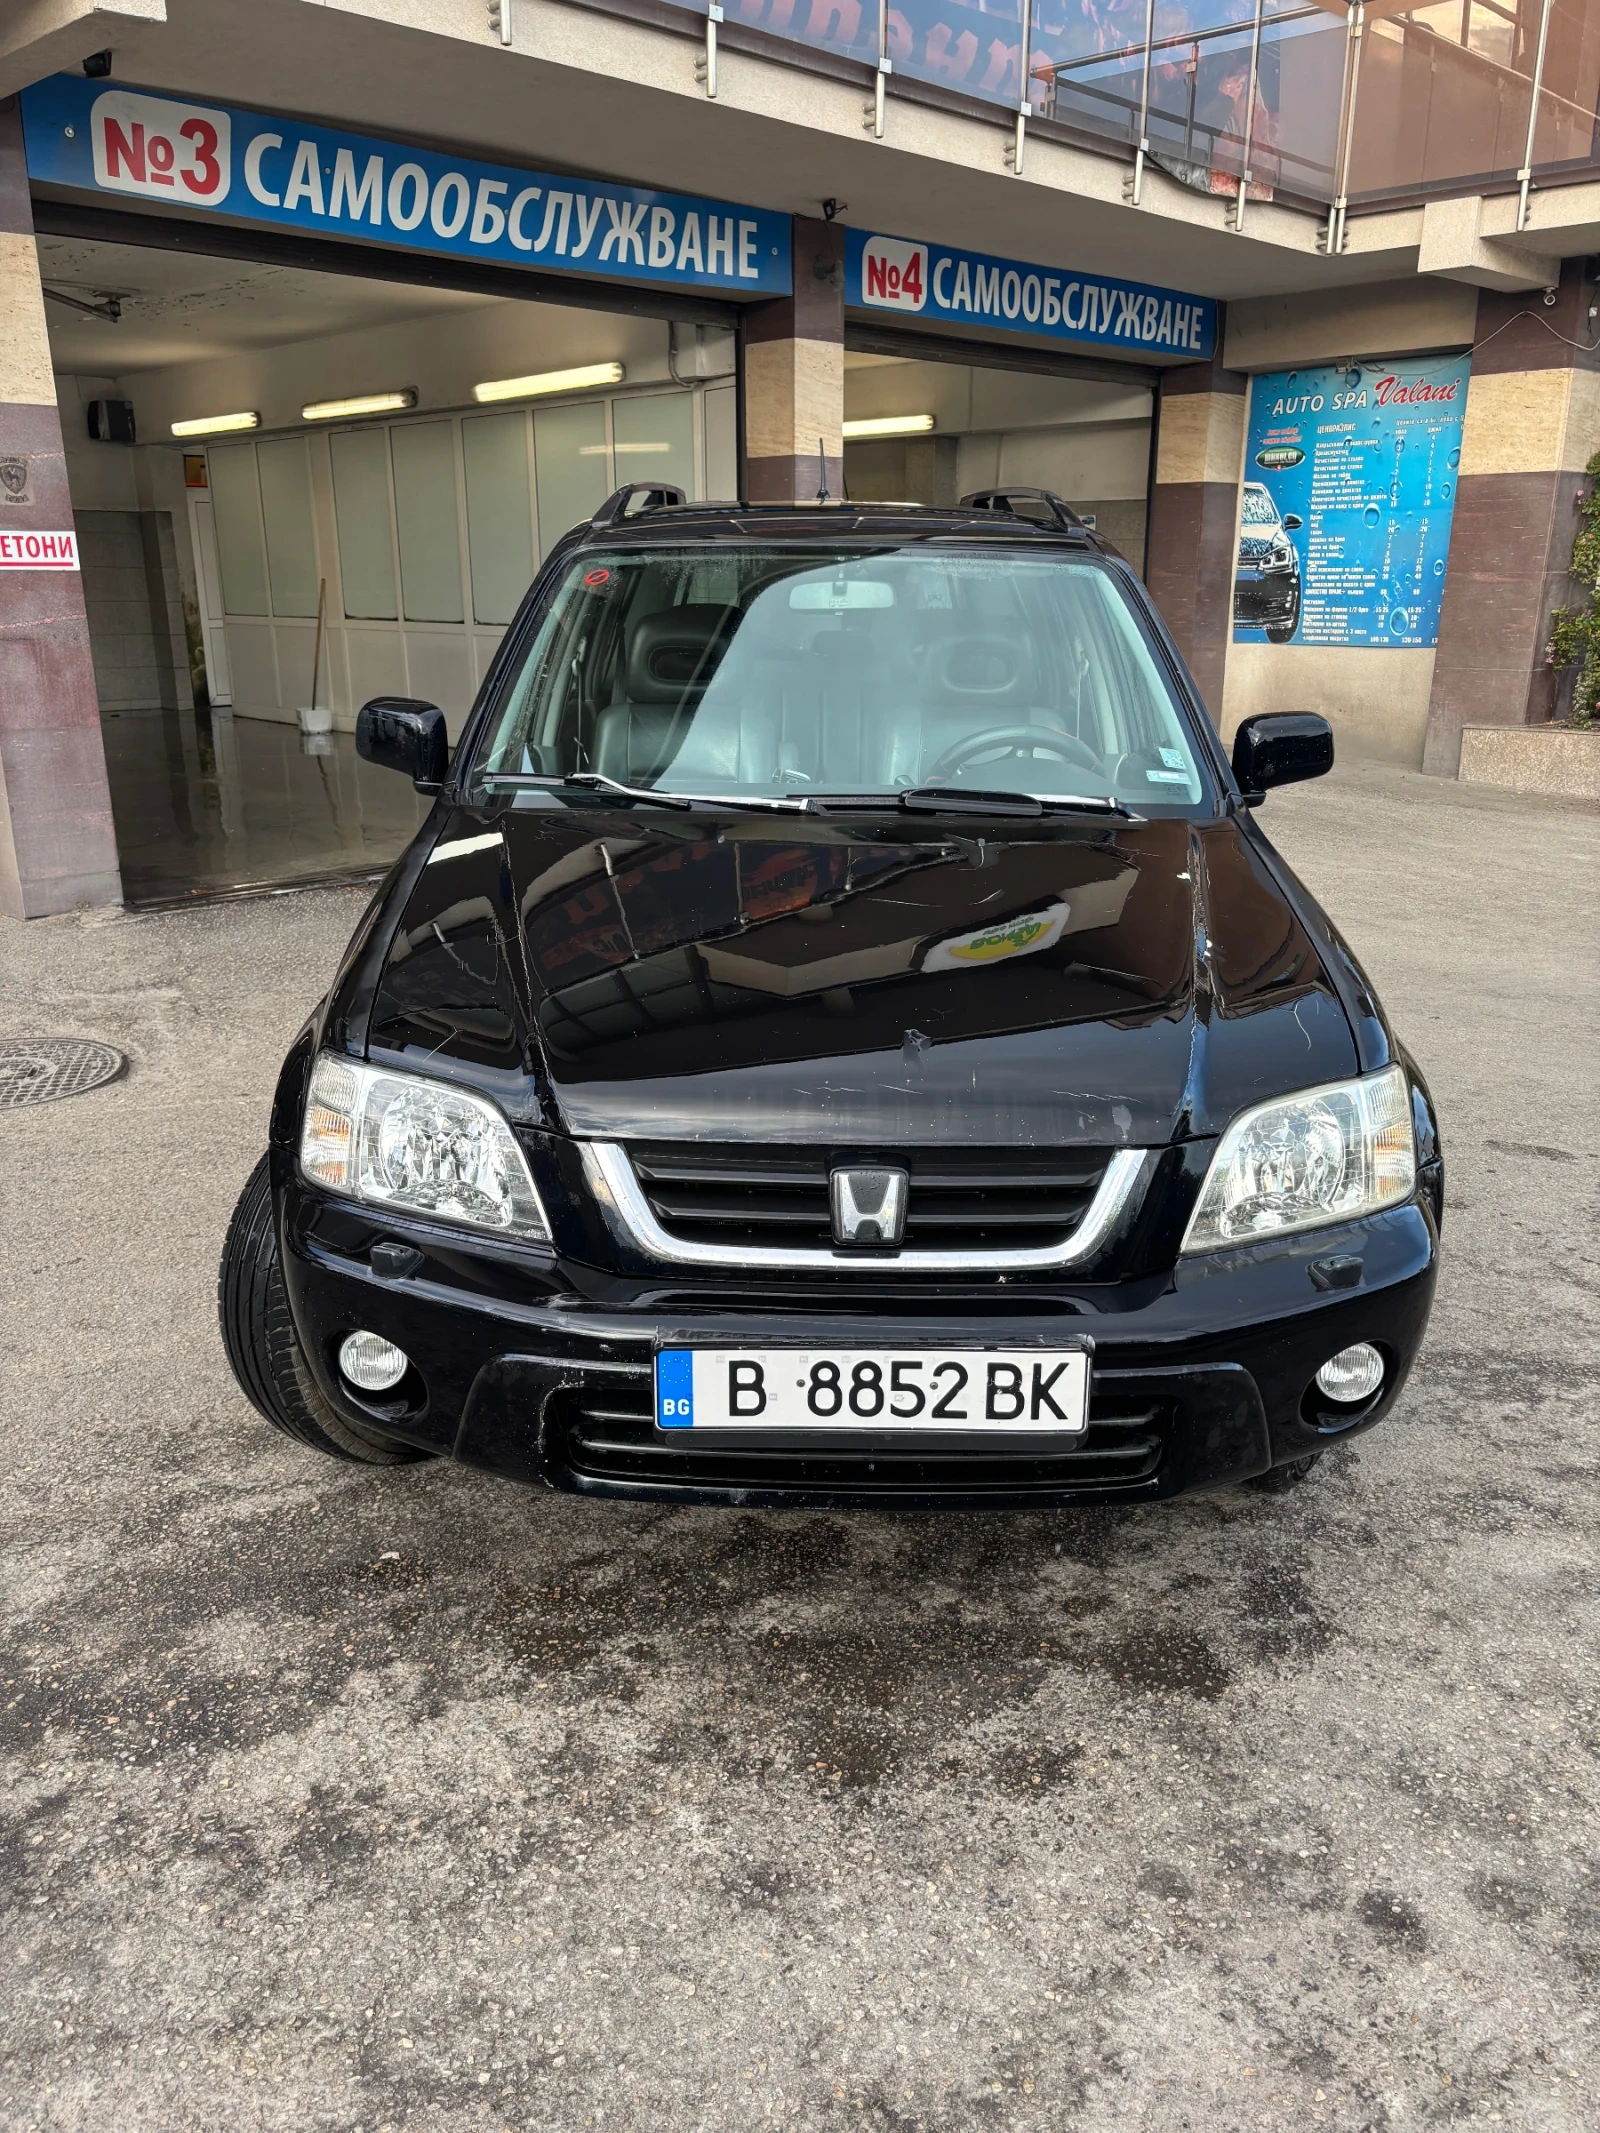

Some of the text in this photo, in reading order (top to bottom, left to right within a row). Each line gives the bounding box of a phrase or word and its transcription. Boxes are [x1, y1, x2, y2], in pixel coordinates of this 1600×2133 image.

[244, 133, 759, 279] САМООБСЛУЖВАНЕ
[932, 258, 1204, 350] САМООБСЛУЖВАНЕ
[1272, 376, 1462, 416] AUTO SPA Valani
[0, 535, 74, 558] ЕТОНИ
[662, 1360, 1069, 1420] BG B 8852 BK
